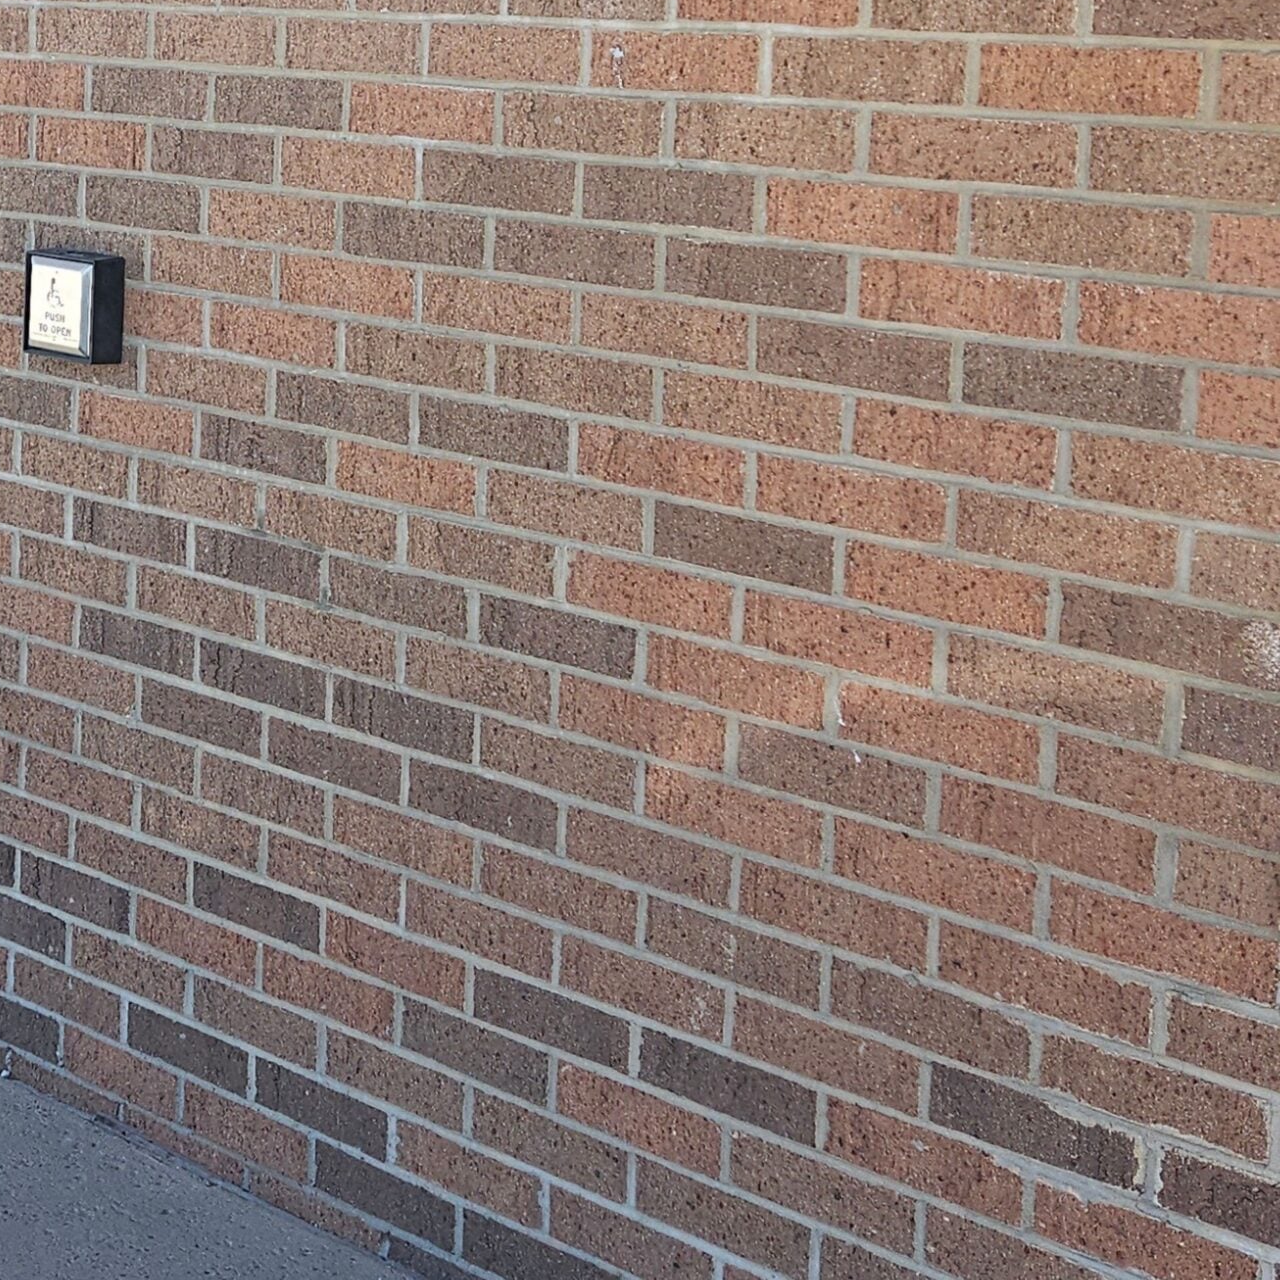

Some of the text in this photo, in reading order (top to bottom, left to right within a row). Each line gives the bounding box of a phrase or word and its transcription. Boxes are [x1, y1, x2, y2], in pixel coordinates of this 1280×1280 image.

[45, 311, 65, 323] PUSH
[38, 322, 48, 333] TO
[50, 325, 72, 337] OPEN
